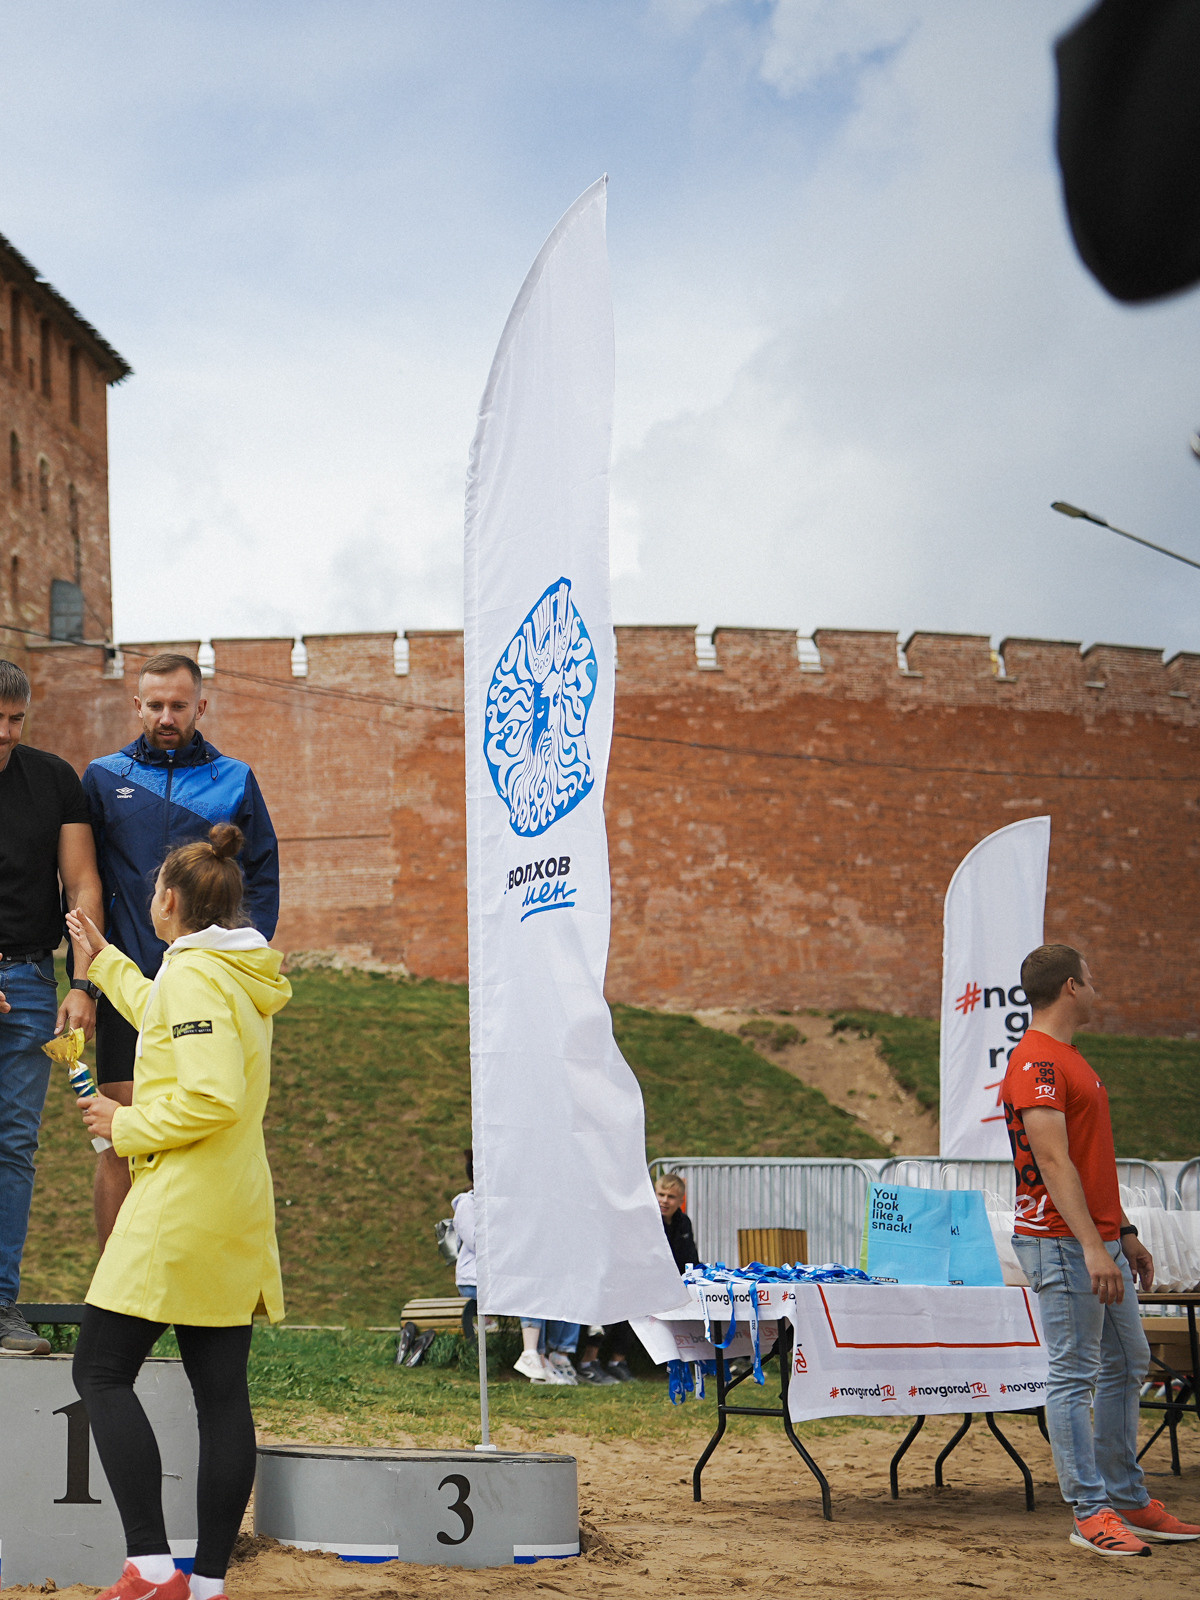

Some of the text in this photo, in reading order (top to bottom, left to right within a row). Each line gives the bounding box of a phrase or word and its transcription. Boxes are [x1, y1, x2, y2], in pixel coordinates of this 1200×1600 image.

[1022, 1061, 1054, 1072] #nov
[1039, 1067, 1055, 1077] go
[1035, 1075, 1055, 1085] rod
[874, 1188, 898, 1201] You
[873, 1199, 899, 1211] look
[872, 1209, 904, 1222] like a
[871, 1221, 912, 1233] snack!
[908, 1381, 990, 1398] #novgorodTRI
[52, 1399, 102, 1504] 1
[436, 1474, 475, 1546] 3
